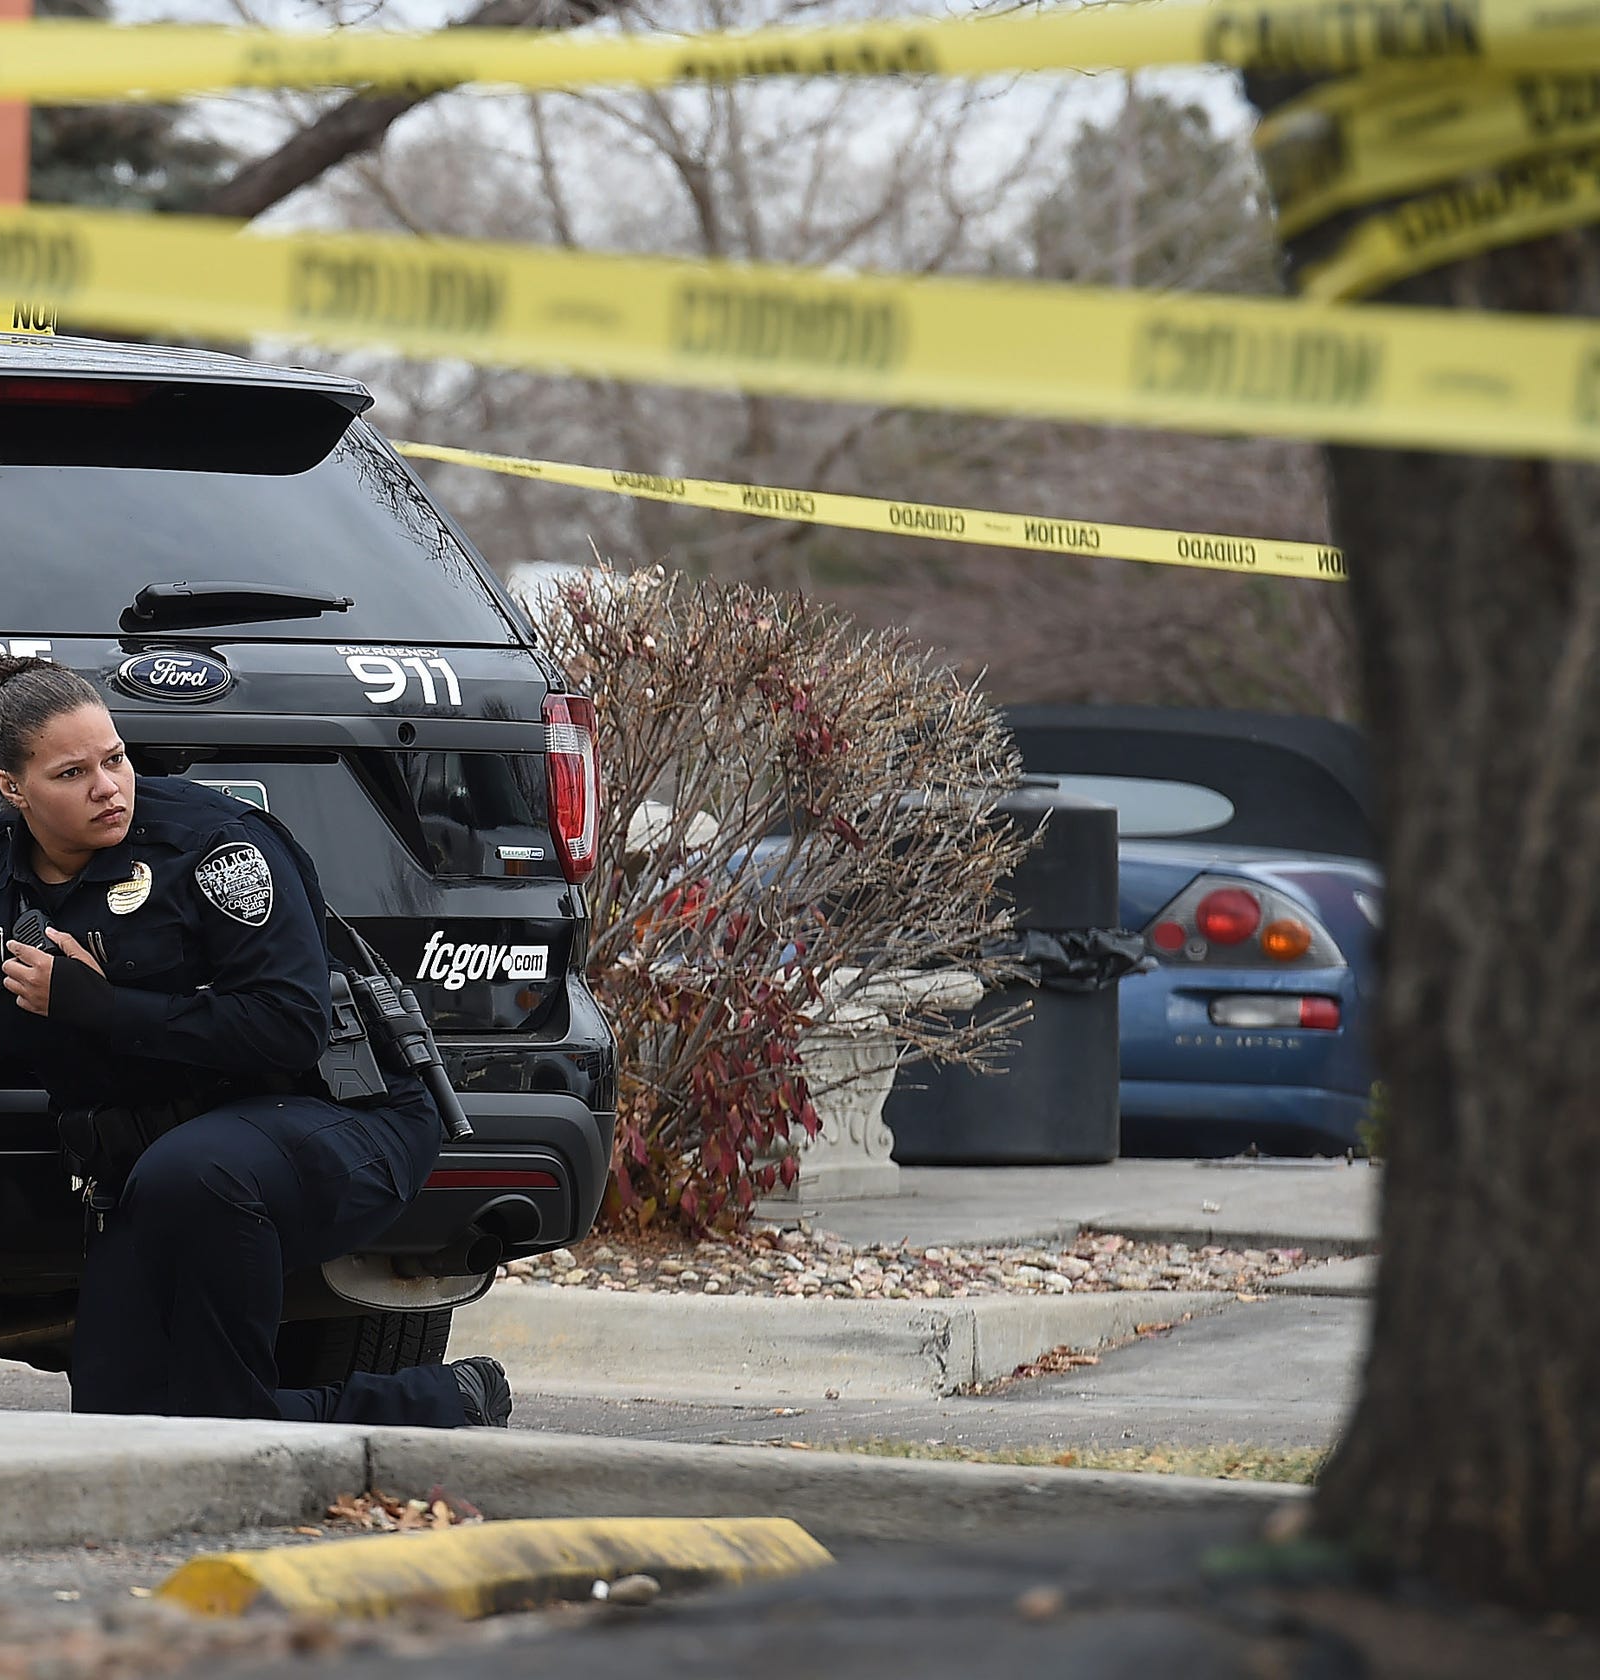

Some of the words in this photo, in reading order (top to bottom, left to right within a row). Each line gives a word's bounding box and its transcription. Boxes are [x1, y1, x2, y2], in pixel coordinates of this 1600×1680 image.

[335, 645, 439, 658] EMERGENCY
[149, 658, 208, 687] Ford
[345, 655, 463, 706] 911
[201, 848, 256, 876] POLICE
[228, 890, 269, 910] Colorado
[240, 899, 266, 915] State
